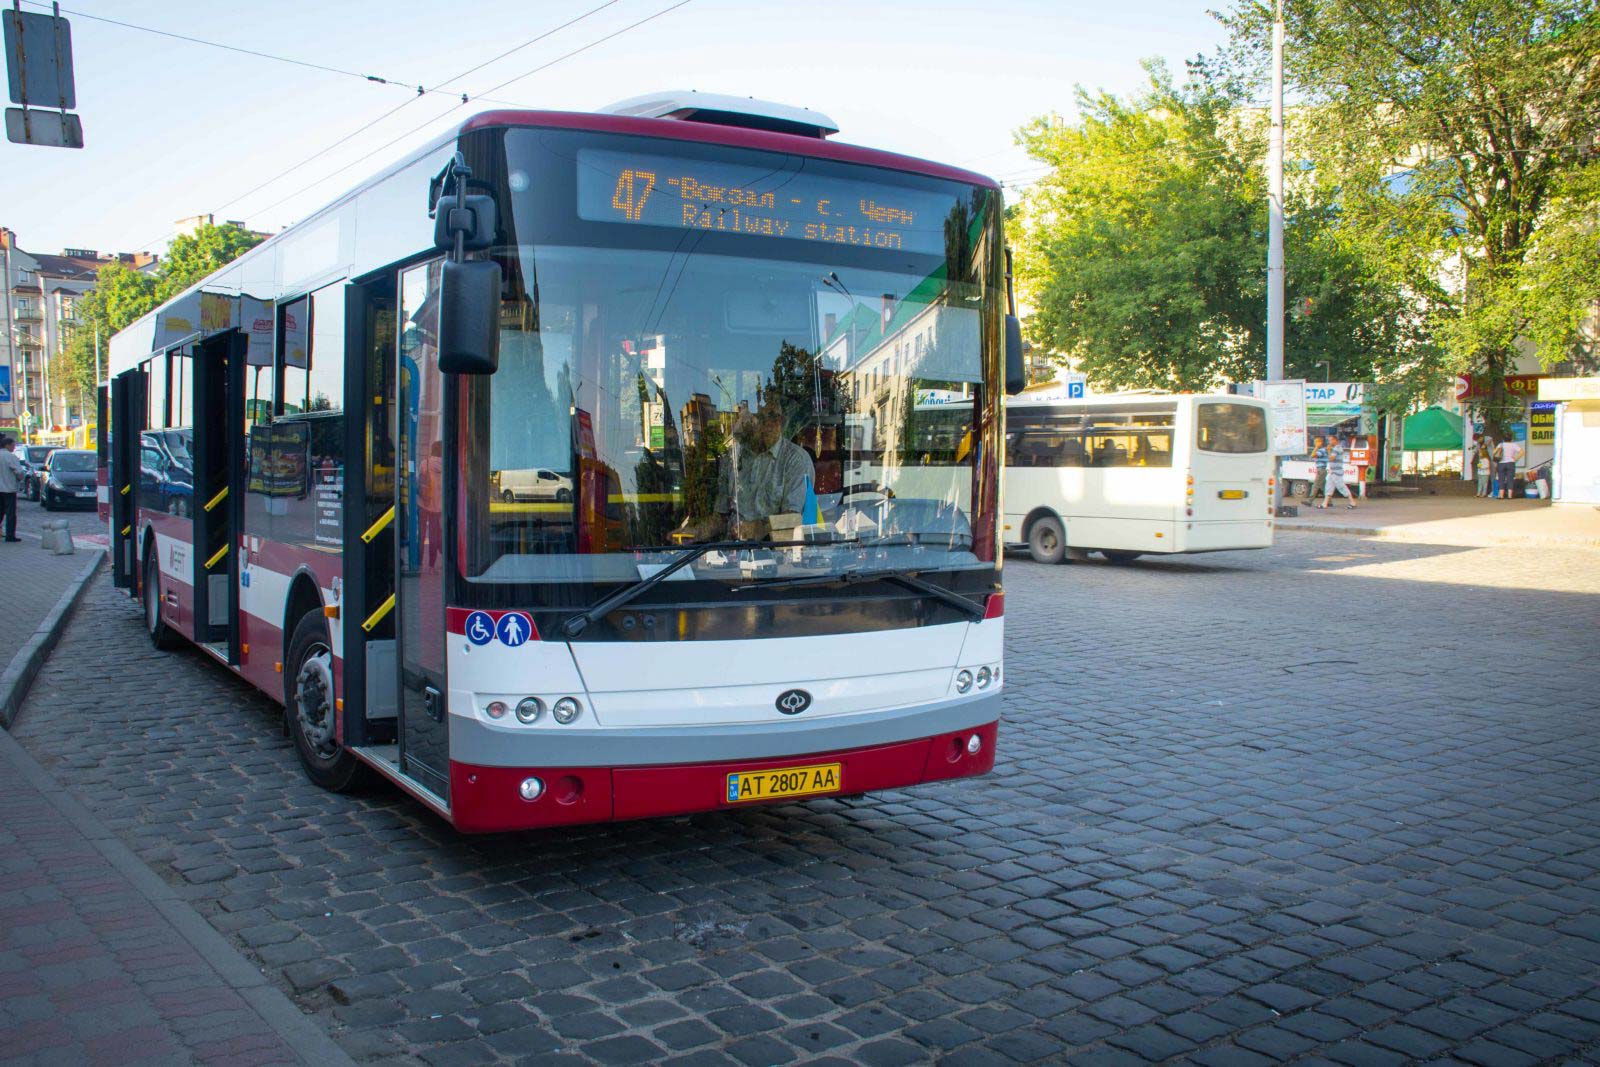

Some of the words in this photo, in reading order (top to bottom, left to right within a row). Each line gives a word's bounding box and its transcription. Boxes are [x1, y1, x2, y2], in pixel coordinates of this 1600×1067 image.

[611, 169, 656, 220] 47
[683, 203, 789, 236] Railway
[804, 222, 901, 249] station
[740, 776, 765, 796] AT
[769, 772, 808, 793] 2807
[812, 769, 835, 789] AA
